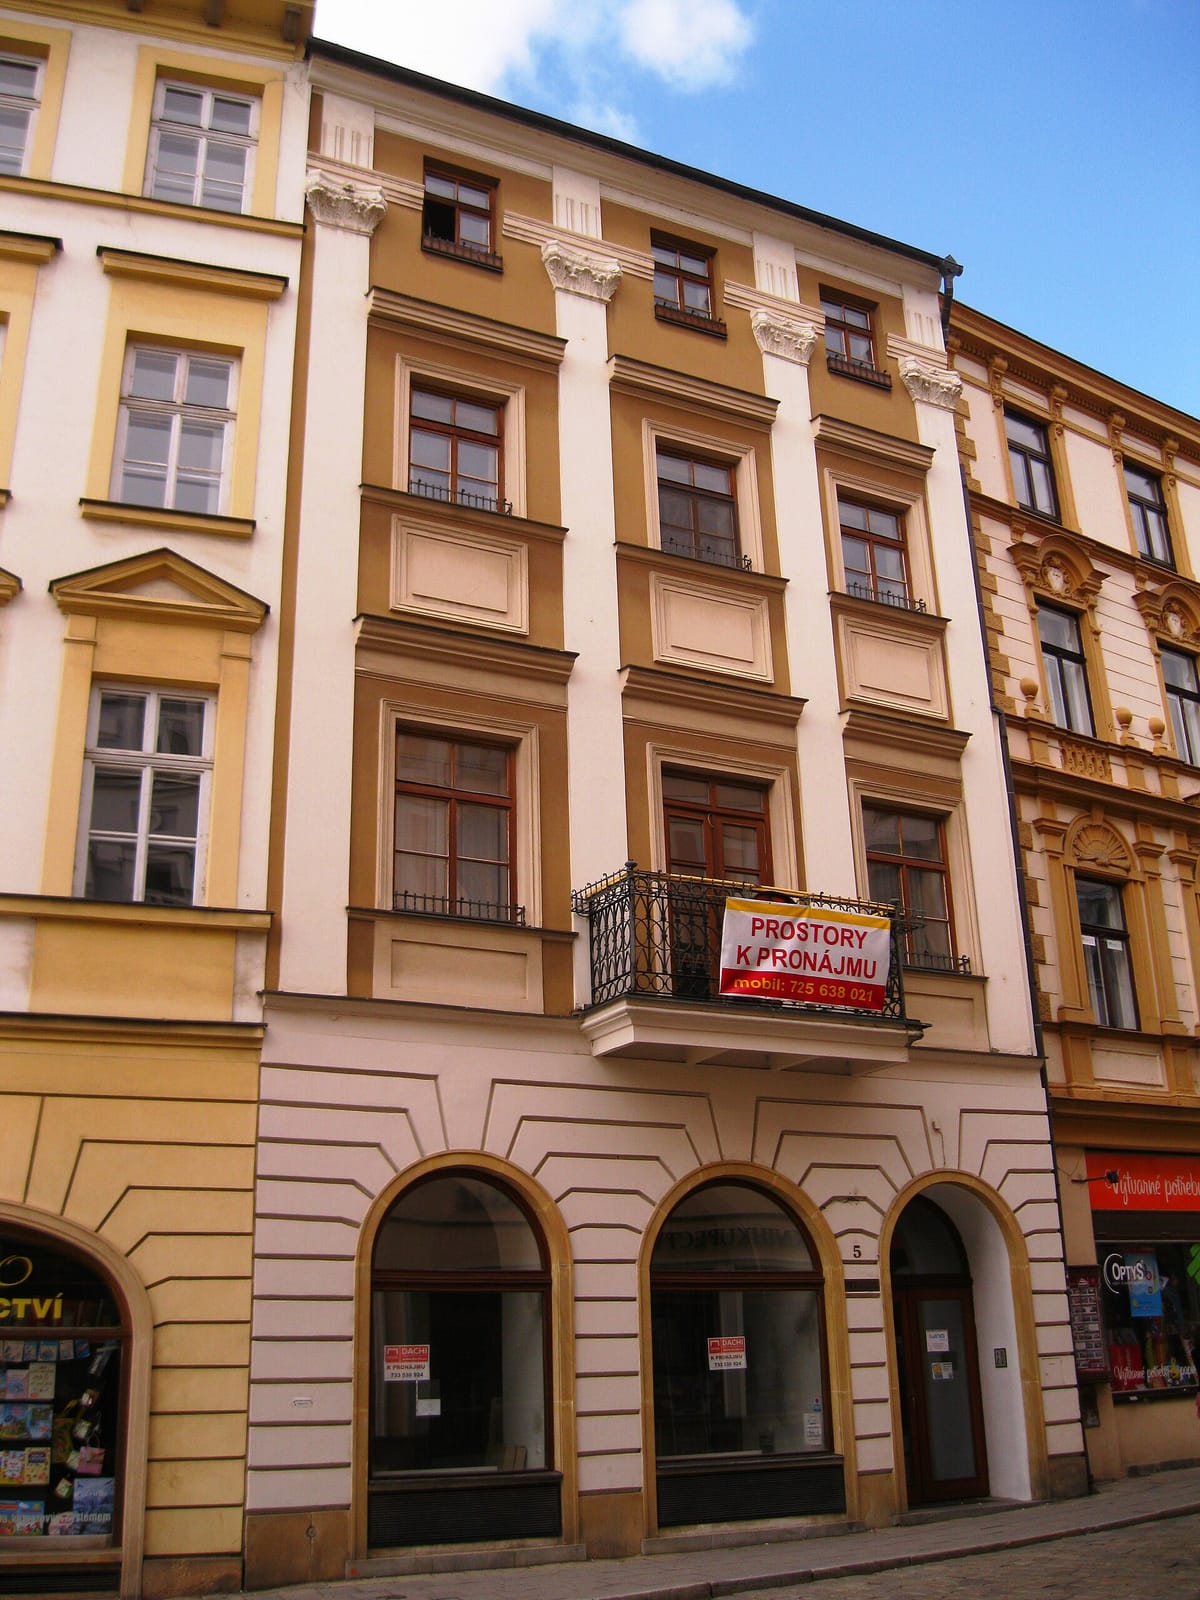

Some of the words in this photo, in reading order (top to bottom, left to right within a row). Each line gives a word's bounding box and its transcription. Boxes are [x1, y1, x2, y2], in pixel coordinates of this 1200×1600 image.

[751, 917, 868, 949] PROSTORY
[736, 944, 752, 966] K
[757, 947, 877, 979] PRONÁJMU
[733, 977, 785, 992] mobil:
[790, 980, 814, 995] 725
[819, 984, 846, 999] 638
[850, 988, 874, 1002] 021
[853, 1244, 862, 1258] 5
